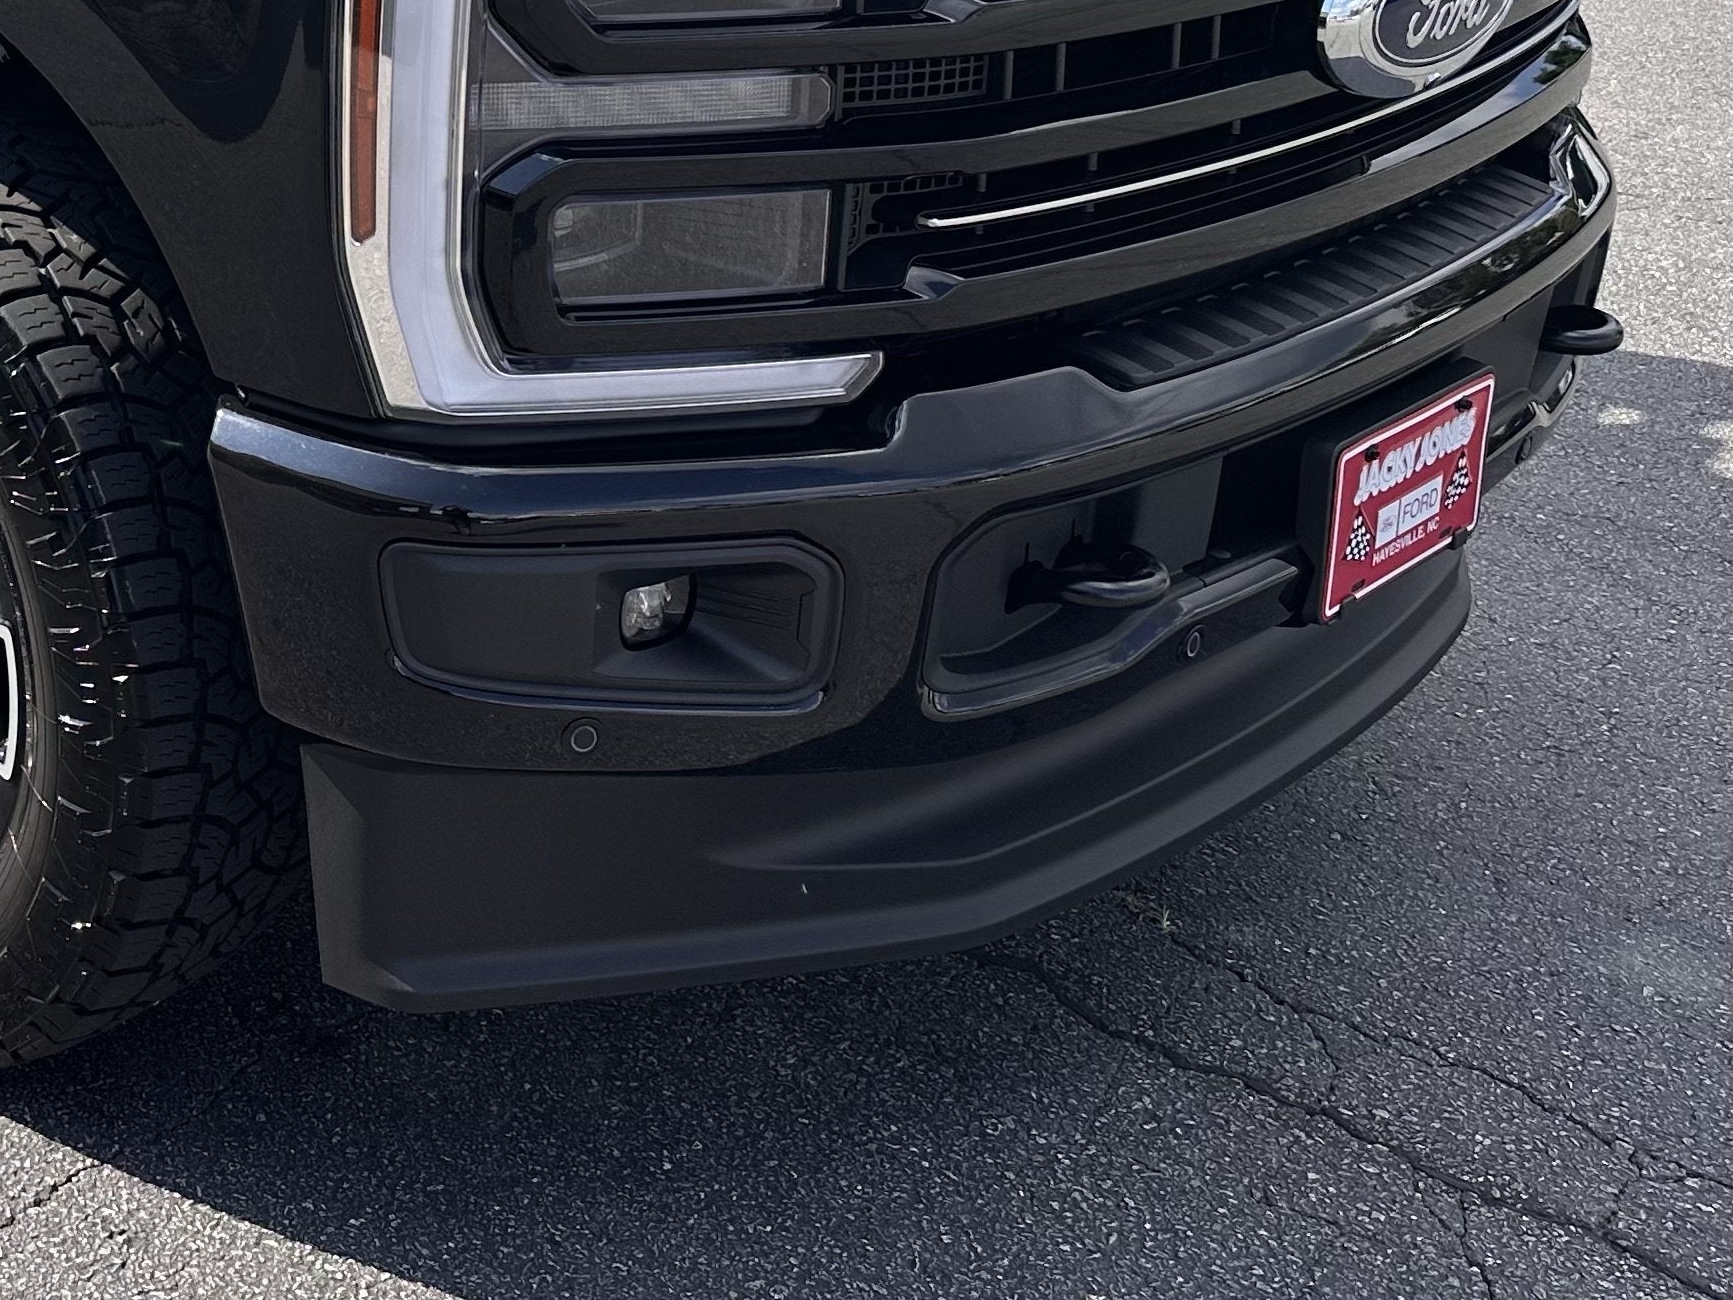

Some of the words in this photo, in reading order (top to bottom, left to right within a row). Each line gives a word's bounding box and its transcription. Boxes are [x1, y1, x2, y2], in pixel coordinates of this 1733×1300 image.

[1353, 437, 1422, 507] JACKY
[1414, 406, 1478, 473] JONES
[1401, 487, 1439, 525] FORD
[1372, 524, 1426, 567] HAYESVILLE
[1426, 516, 1441, 534] NC
